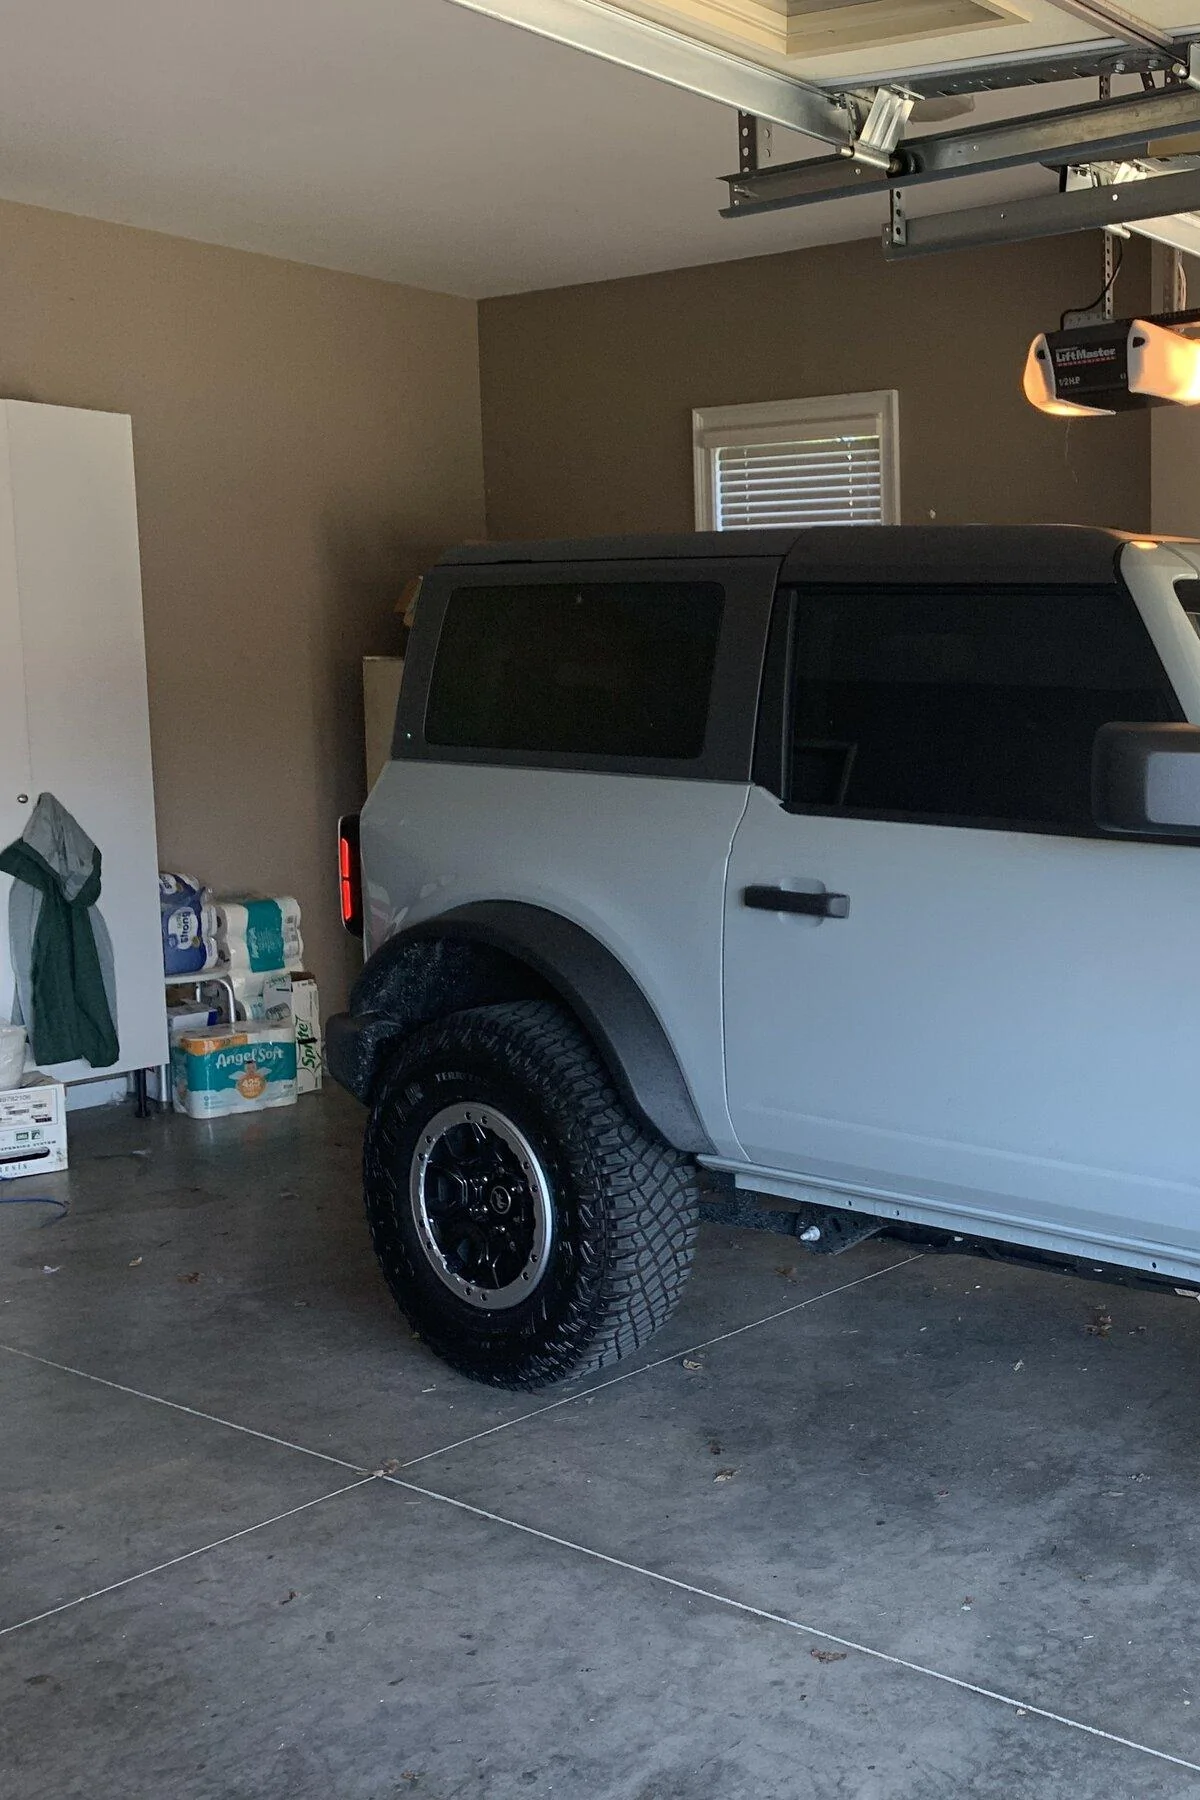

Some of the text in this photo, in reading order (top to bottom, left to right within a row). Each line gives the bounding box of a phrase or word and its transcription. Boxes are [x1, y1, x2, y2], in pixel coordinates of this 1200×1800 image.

[1055, 347, 1117, 363] LiftMaster
[180, 911, 191, 944] Strong
[216, 1045, 285, 1069] Angel Soft
